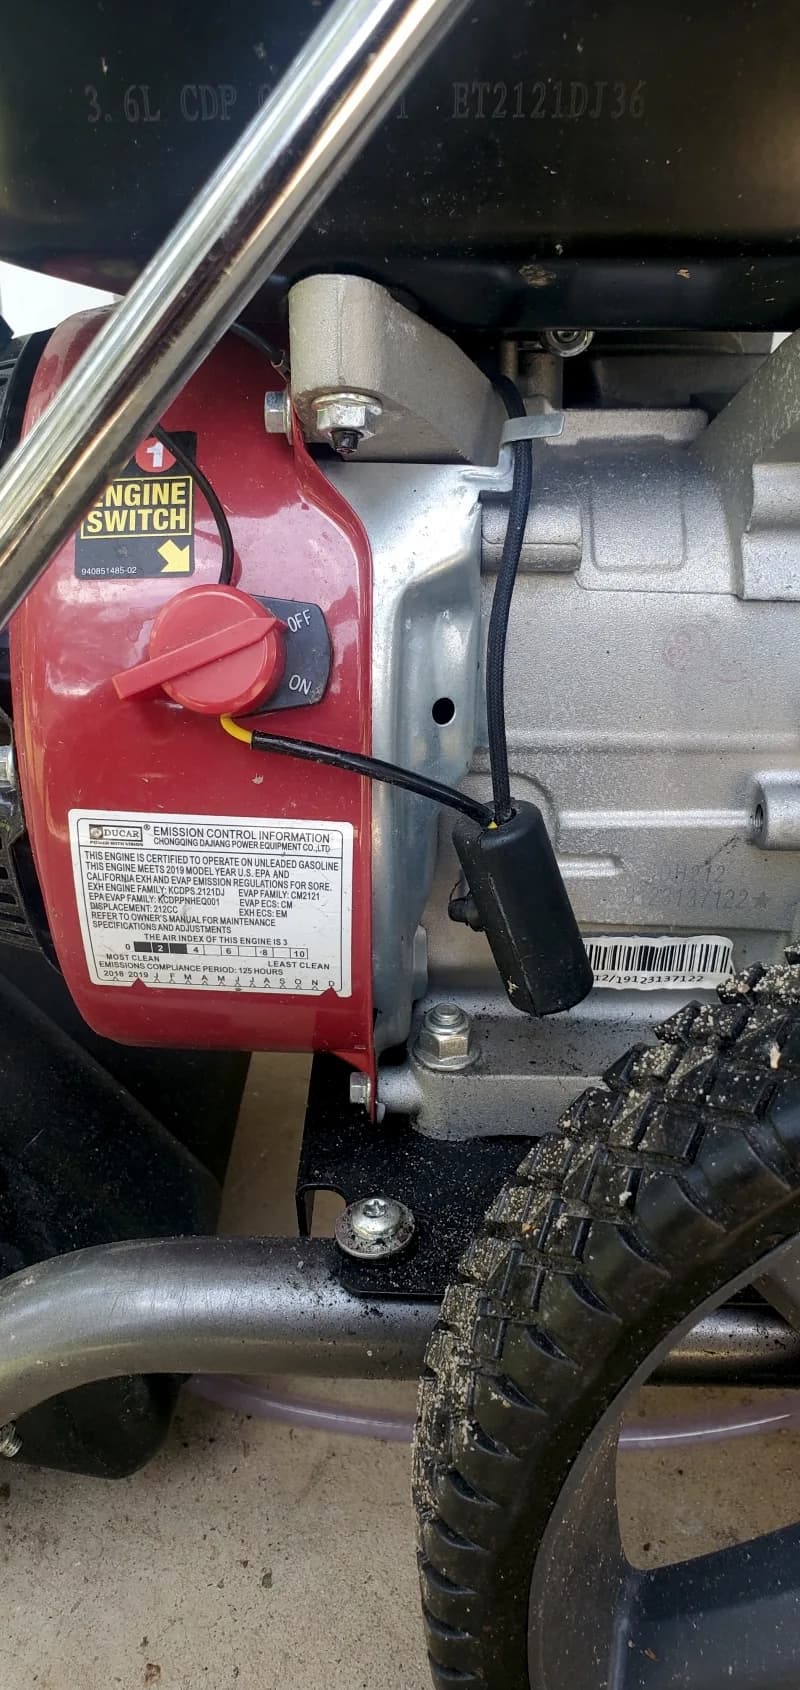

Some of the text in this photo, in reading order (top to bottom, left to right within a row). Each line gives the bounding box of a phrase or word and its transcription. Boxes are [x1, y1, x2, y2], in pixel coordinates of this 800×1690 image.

[180, 84, 237, 120] CDP
[452, 81, 647, 119] ET2121DJ36
[146, 442, 164, 467] 1
[87, 508, 185, 532] SWITCH
[82, 567, 137, 575] 940851485-02
[288, 609, 310, 632] OFF
[289, 675, 311, 695] ON
[104, 829, 139, 838] DUCAR
[154, 827, 330, 843] EMISSION CONTROL INFORMATION
[154, 838, 198, 847] CHONGQING
[200, 840, 230, 848] DAJIANG
[260, 842, 301, 850] EQUIPMENT
[84, 851, 338, 871] THIS ENGINE IS CERTIFIED TO OPERATE ON UNLEADED GASOLINE
[85, 862, 289, 878] THIS ENGINE MEETS 2019 MODEL YEAR U.S. EPA AND
[87, 872, 134, 882] CALIFORNIA
[136, 875, 151, 883] EXH
[153, 876, 169, 884] AND
[171, 876, 191, 884] EVAP
[193, 877, 231, 886] EMISSION
[233, 878, 288, 889] REGULATIONS
[290, 881, 306, 889] FOR
[88, 882, 104, 891] EXH
[106, 883, 136, 892] ENGINE
[137, 885, 167, 893] FAMILY:
[105, 893, 125, 901] EVAP
[127, 894, 156, 903] FAMILY:
[239, 889, 258, 897] EVAP
[260, 890, 289, 899] FAMILY:
[90, 902, 152, 912] DISPLACEMENT:
[261, 900, 279, 908] ECS:
[131, 914, 167, 922] OWNER'S
[169, 915, 200, 923] MANUAL
[220, 917, 275, 926] MAINTENANCE
[93, 921, 156, 930] SPECIFICATIONS
[176, 925, 231, 933] ADJUSTMENTS
[594, 975, 704, 984] 12/19123137122
